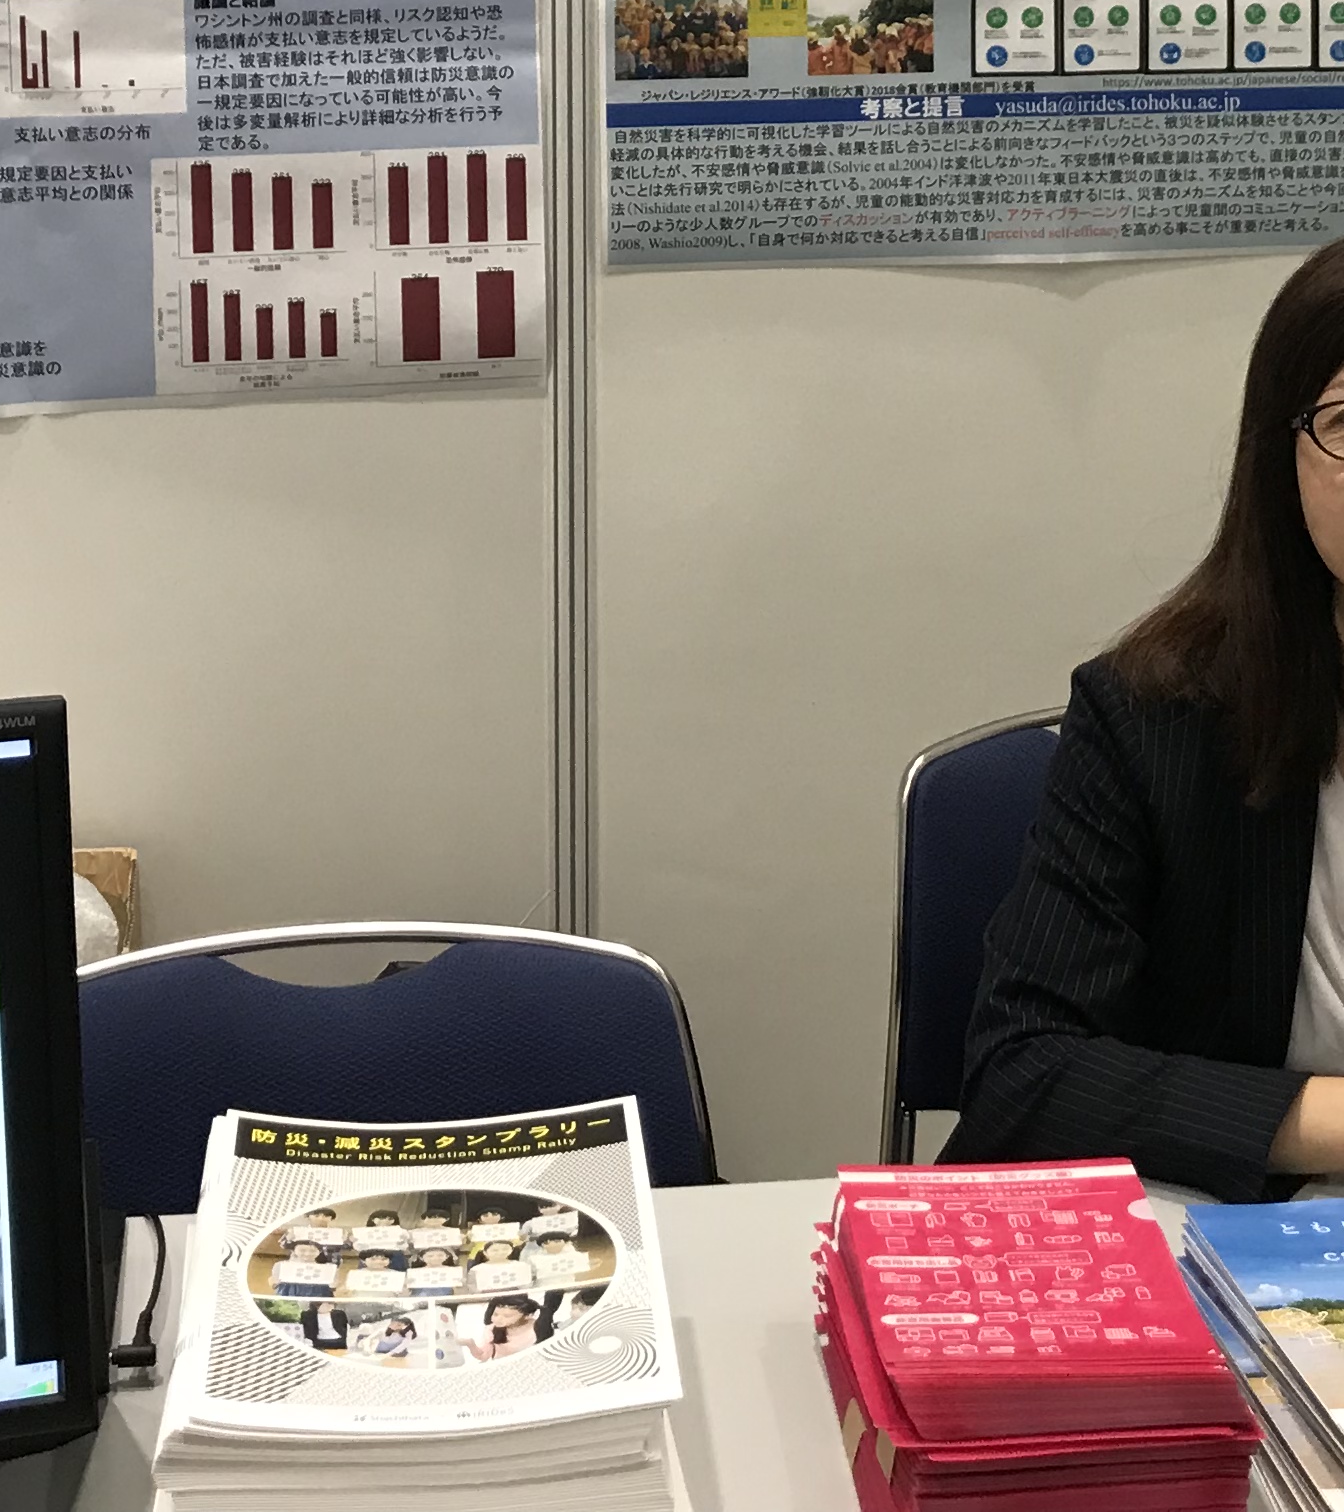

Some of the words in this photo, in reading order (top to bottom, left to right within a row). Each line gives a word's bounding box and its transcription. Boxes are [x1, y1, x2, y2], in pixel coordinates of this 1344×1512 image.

[194, 5, 503, 30] ワシントン州の調査と同様、リスク認知や恐
[196, 46, 502, 70] ただ、被害経験はそれほど強く影響しない。
[197, 65, 514, 90] 日本調査で加えた一般的信頼は防災意識の
[860, 96, 964, 120] 考察と提言
[995, 94, 1241, 116] yasuda@irides.tohoku.ac.jp
[14, 123, 151, 145] 支払い意志の分布
[0, 183, 134, 205] 意志平均との関係
[251, 1118, 611, 1151] 防災・減災スタンプラリー
[286, 1148, 353, 1161] Disaster
[358, 1152, 393, 1162] Risk
[398, 1149, 477, 1161] Reduction
[483, 1143, 532, 1157] Stamp
[537, 1136, 578, 1149] Rally
